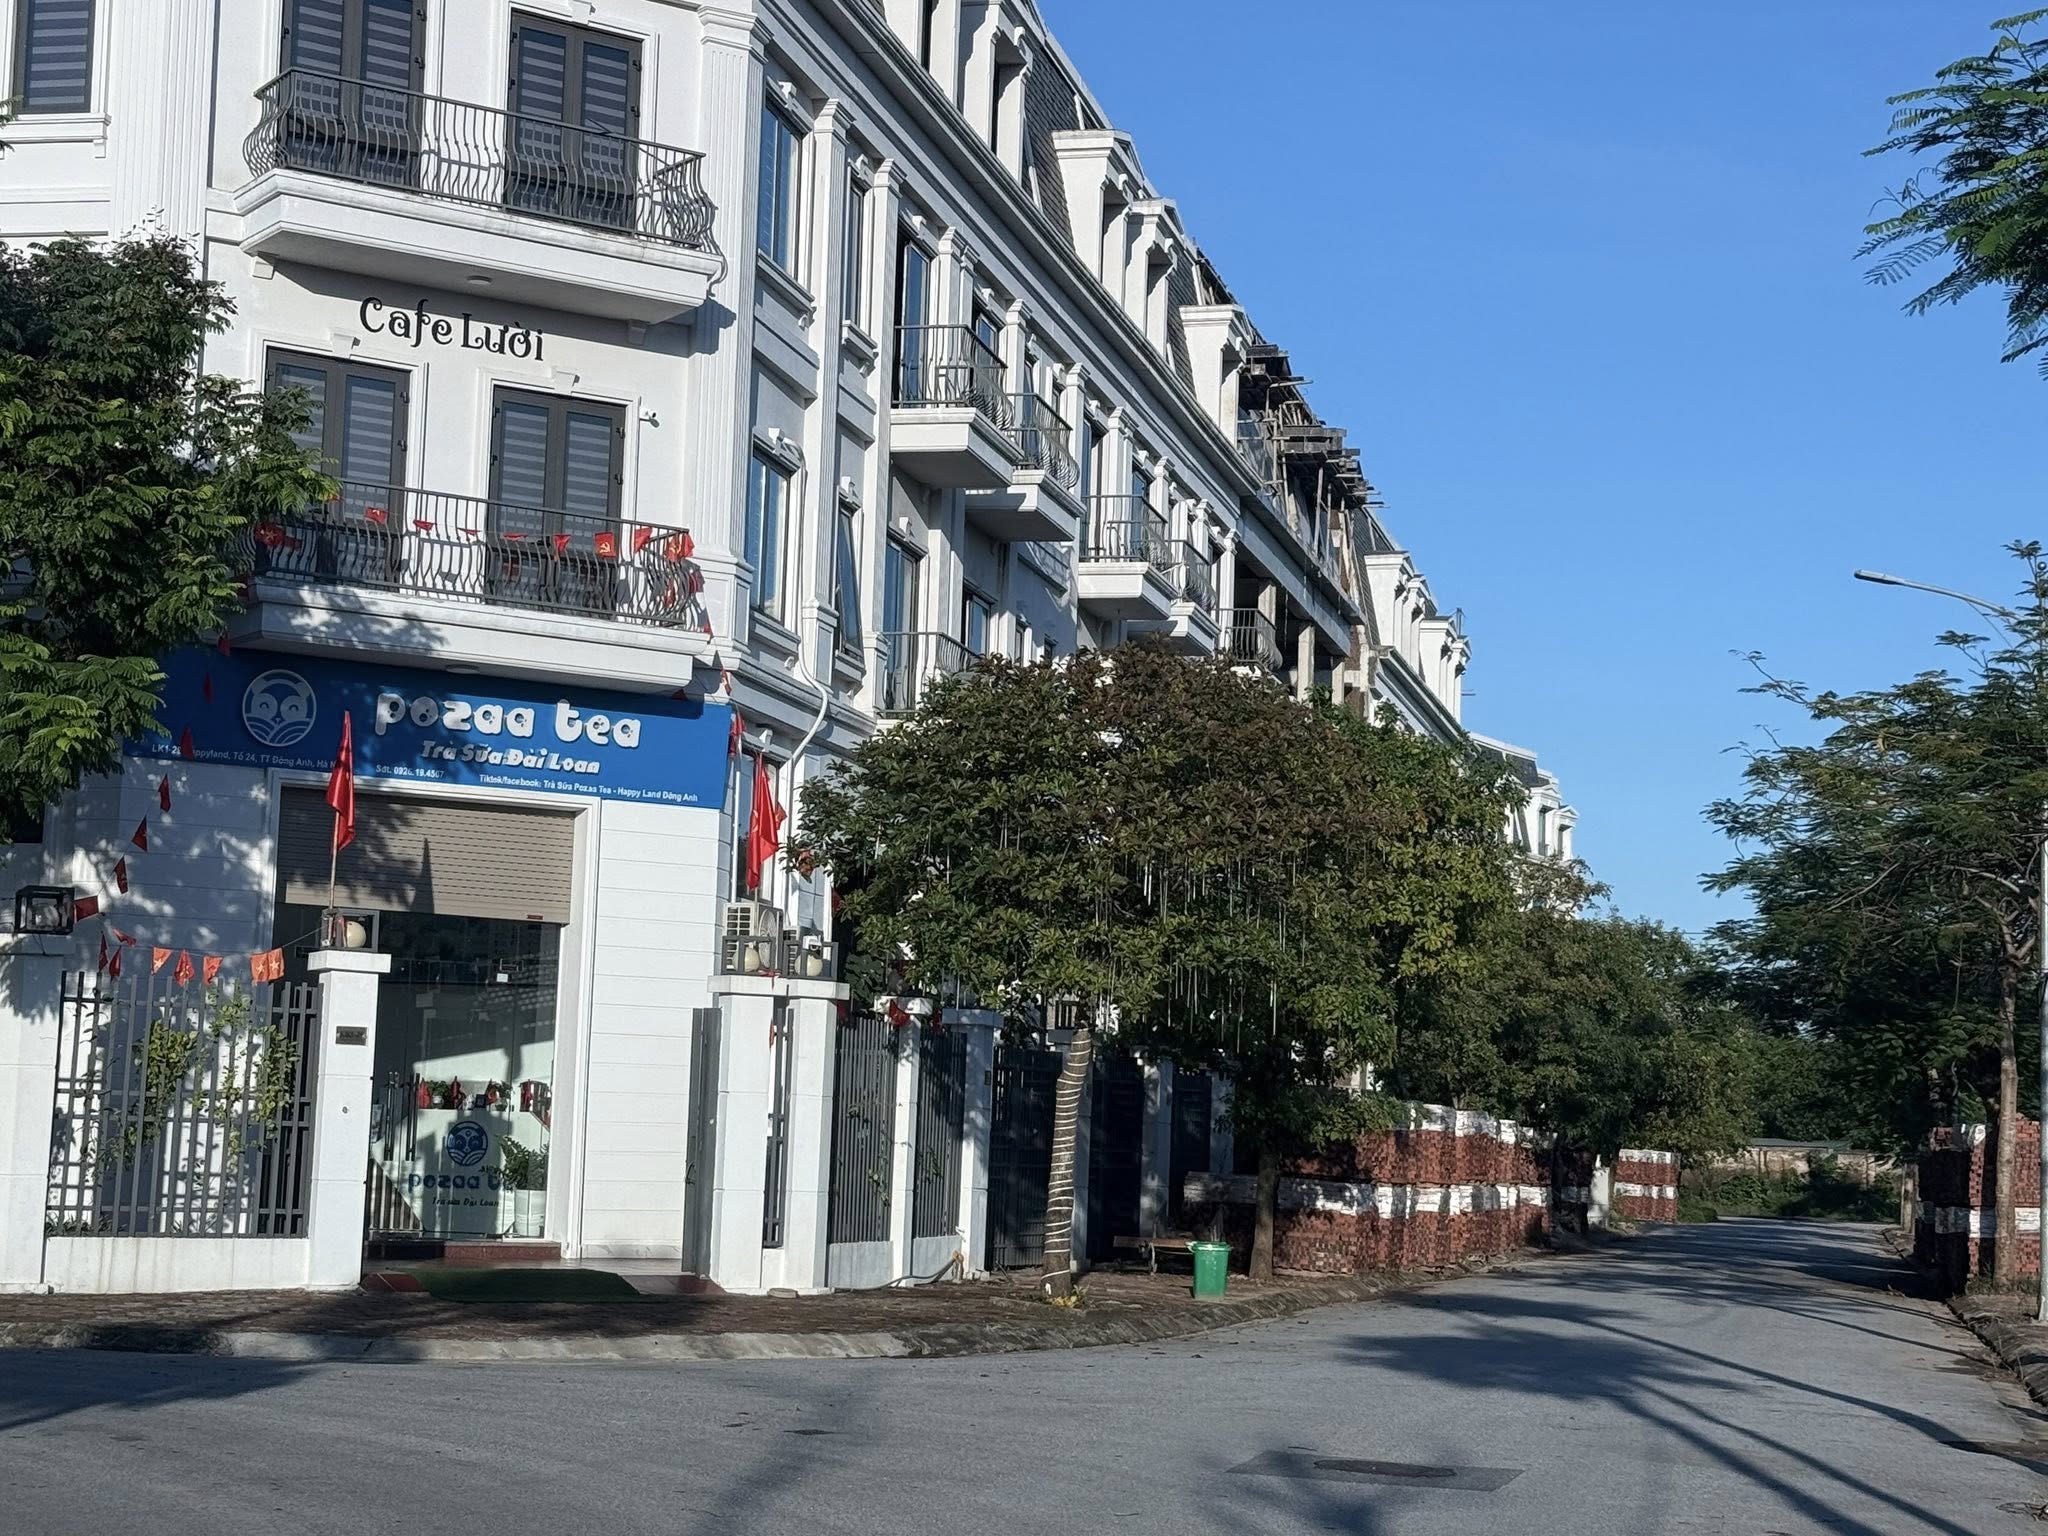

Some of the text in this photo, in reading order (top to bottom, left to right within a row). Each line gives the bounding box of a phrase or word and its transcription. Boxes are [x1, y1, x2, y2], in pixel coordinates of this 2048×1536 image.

[359, 296, 544, 361] Cafe Lười
[375, 692, 641, 749] pozaa tea
[260, 754, 270, 763] TT
[421, 740, 600, 774] Trà Sữa Đài Loan
[598, 785, 612, 794] Tea
[617, 786, 641, 799] Happy
[642, 789, 661, 799] Land
[682, 793, 698, 802] Anh
[408, 1172, 480, 1194] pozaa
